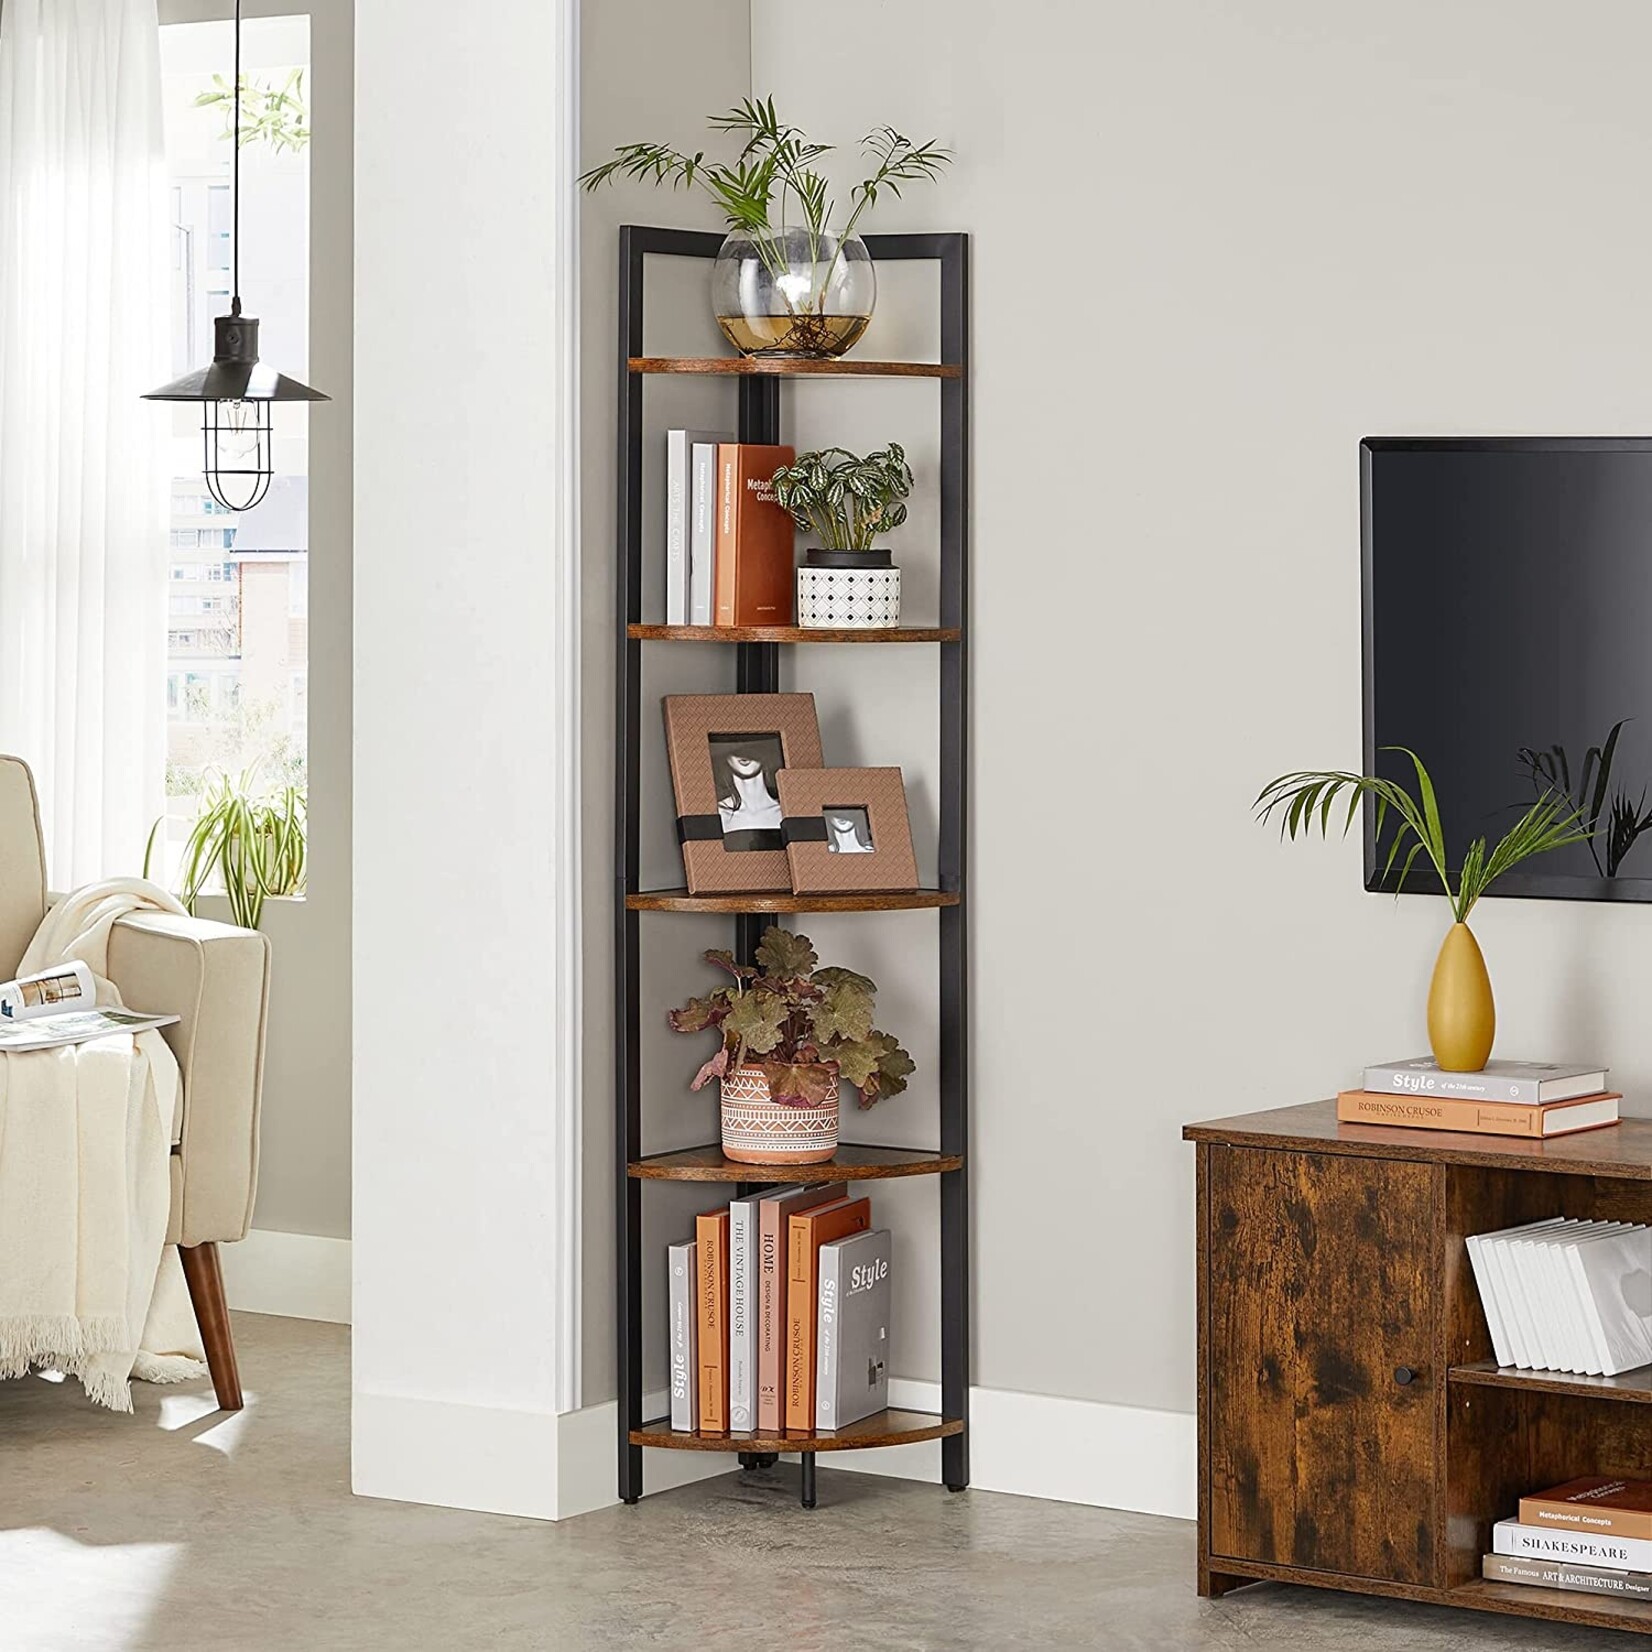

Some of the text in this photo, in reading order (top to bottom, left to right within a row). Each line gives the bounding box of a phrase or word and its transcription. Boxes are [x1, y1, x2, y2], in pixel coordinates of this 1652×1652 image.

[1392, 1073, 1435, 1091] Style
[1358, 1102, 1405, 1114] ROBINSON
[1406, 1106, 1443, 1117] CRUSOE
[706, 1240, 714, 1290] ROBINSON
[764, 1234, 774, 1274] HOME
[736, 1221, 744, 1337] THE VINTAGE HOUSE
[851, 1258, 888, 1290] Style
[707, 1292, 716, 1329] CRUSOE
[821, 1279, 836, 1324] Style
[793, 1318, 801, 1356] CRUSOE
[673, 1354, 687, 1399] Style
[792, 1358, 800, 1407] ROBINSON
[1539, 1511, 1612, 1527] Metaphorical Concepts
[1522, 1537, 1628, 1560] SHAKESPEARE
[1499, 1565, 1513, 1574] The
[1513, 1566, 1540, 1578] Famous
[1625, 1583, 1650, 1592] Designer
